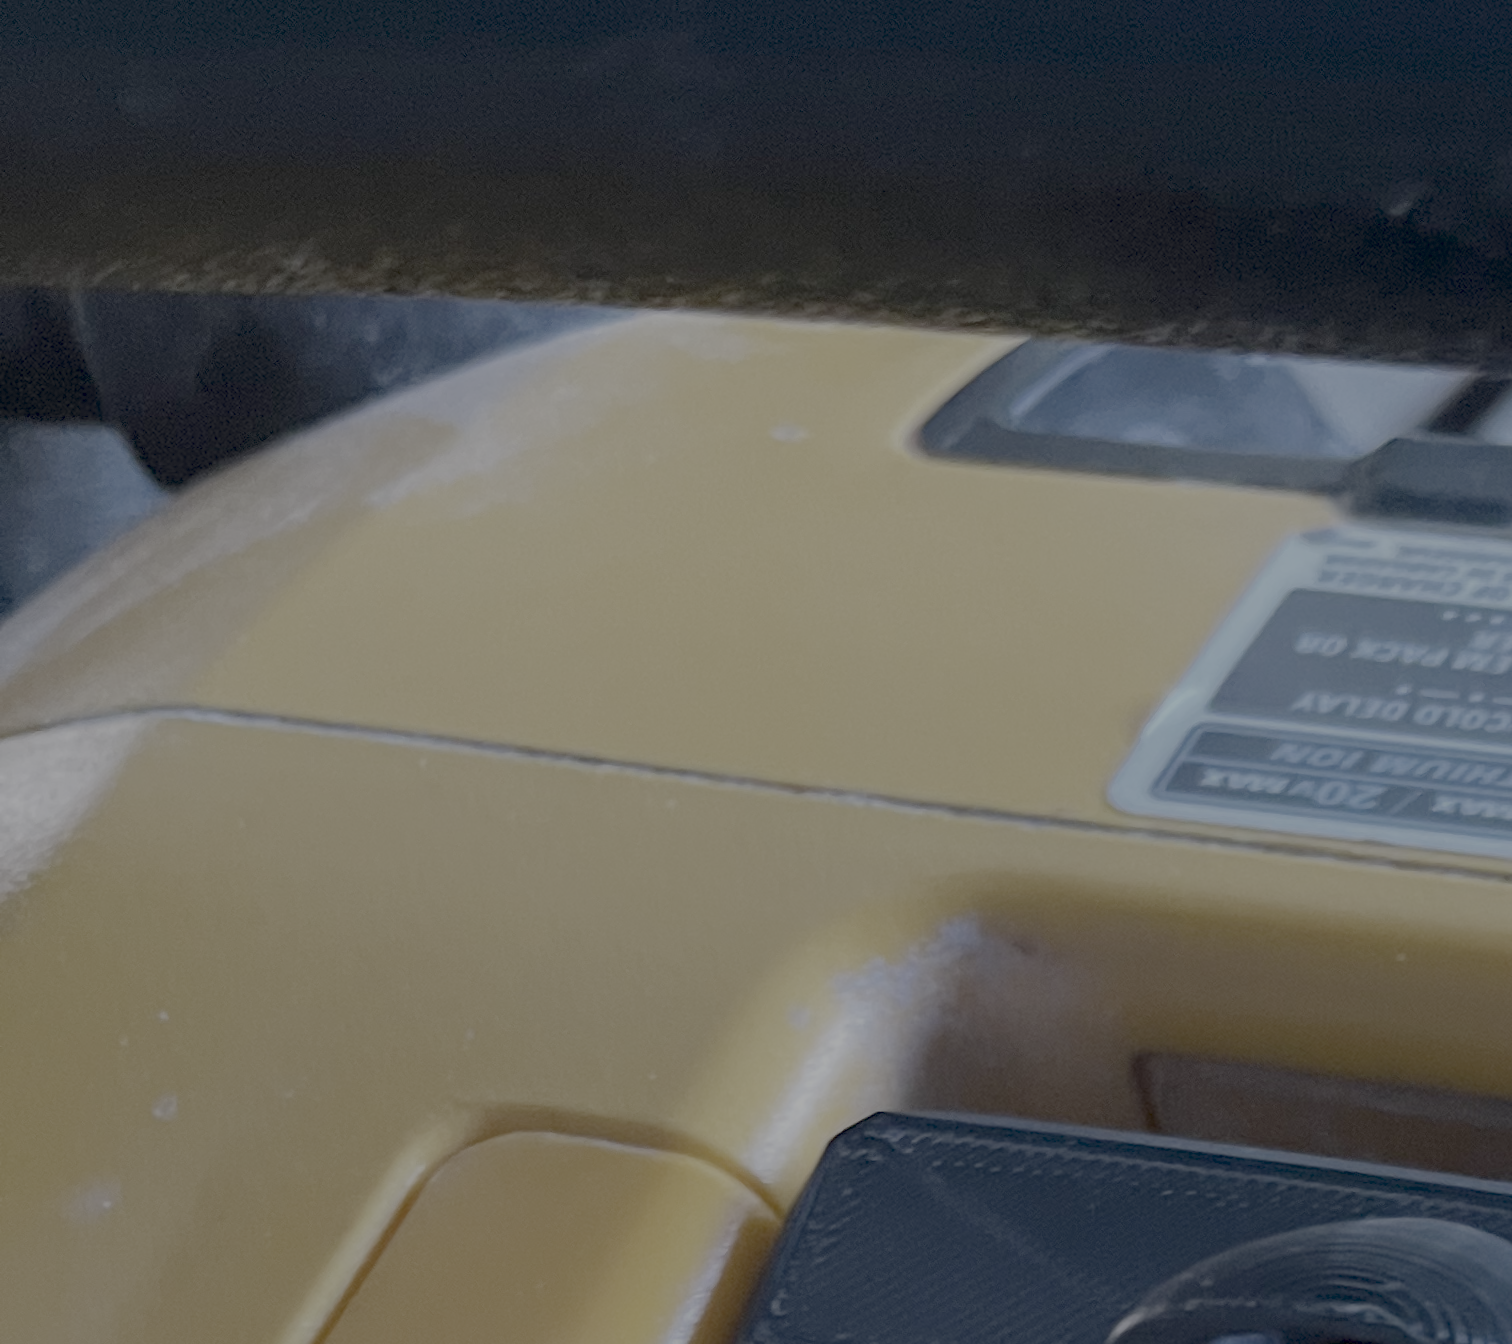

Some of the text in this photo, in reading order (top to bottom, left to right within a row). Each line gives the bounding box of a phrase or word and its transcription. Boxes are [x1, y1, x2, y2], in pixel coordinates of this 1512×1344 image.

[1293, 631, 1347, 656] OR
[1348, 637, 1450, 668] PACK
[1286, 690, 1409, 724] DELAY
[1268, 742, 1364, 769] ION
